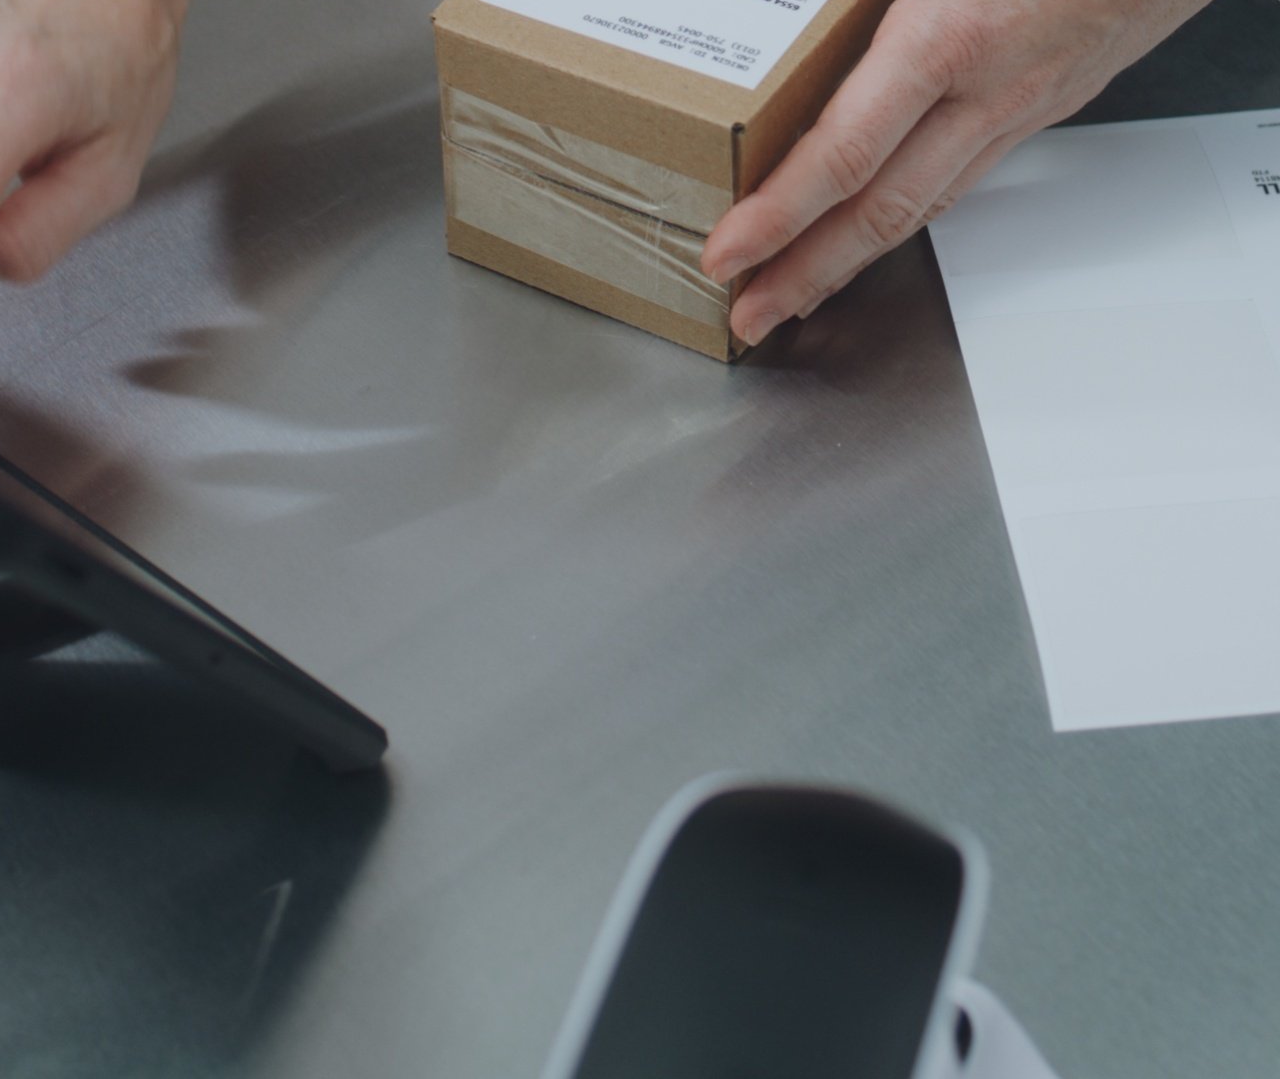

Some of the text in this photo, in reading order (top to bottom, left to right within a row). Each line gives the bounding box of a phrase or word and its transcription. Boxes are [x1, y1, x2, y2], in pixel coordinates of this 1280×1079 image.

[582, 14, 648, 40] 00002330670
[677, 25, 760, 56] (013) 750-0045
[690, 48, 707, 57] ID:
[734, 52, 756, 63] CAD:
[711, 55, 749, 71] ORIGIN
